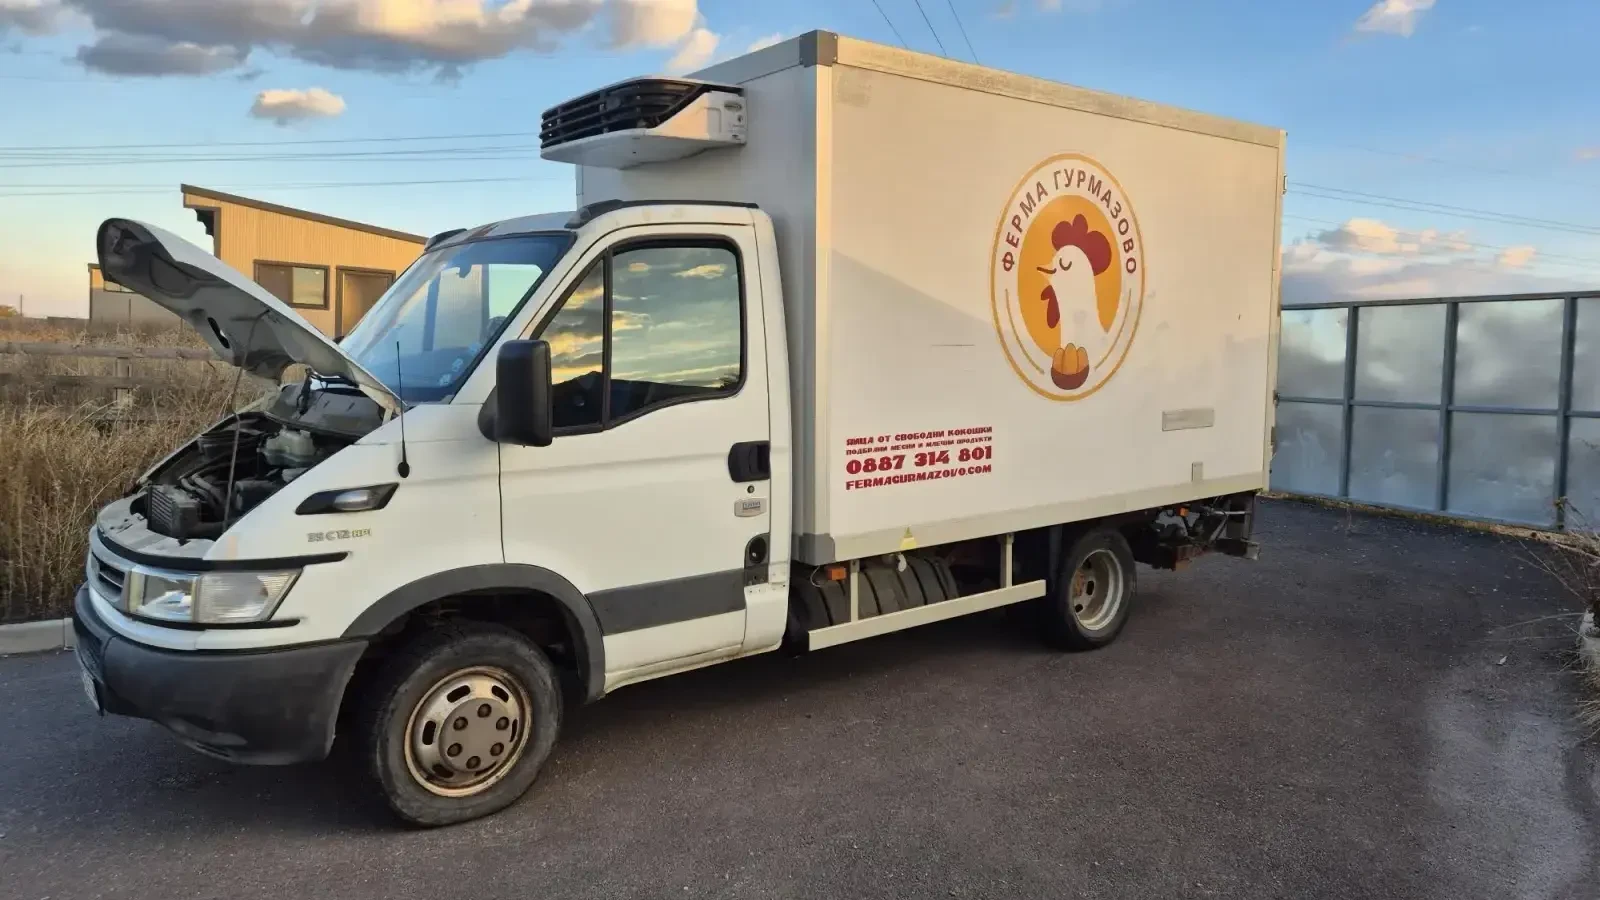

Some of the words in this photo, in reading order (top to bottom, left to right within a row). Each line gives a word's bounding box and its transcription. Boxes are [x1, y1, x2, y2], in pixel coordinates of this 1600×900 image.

[1002, 181, 1049, 272] ФЕРМА
[1053, 168, 1137, 274] ГУРМАЗОВО
[846, 437, 874, 446] ЯИЦА
[877, 435, 891, 443] ОТ
[895, 430, 945, 442] СВОБОДНИ
[948, 426, 993, 437] КОКОШКИ
[846, 454, 906, 475] 0887
[914, 449, 950, 467] 314
[958, 445, 992, 462] 801
